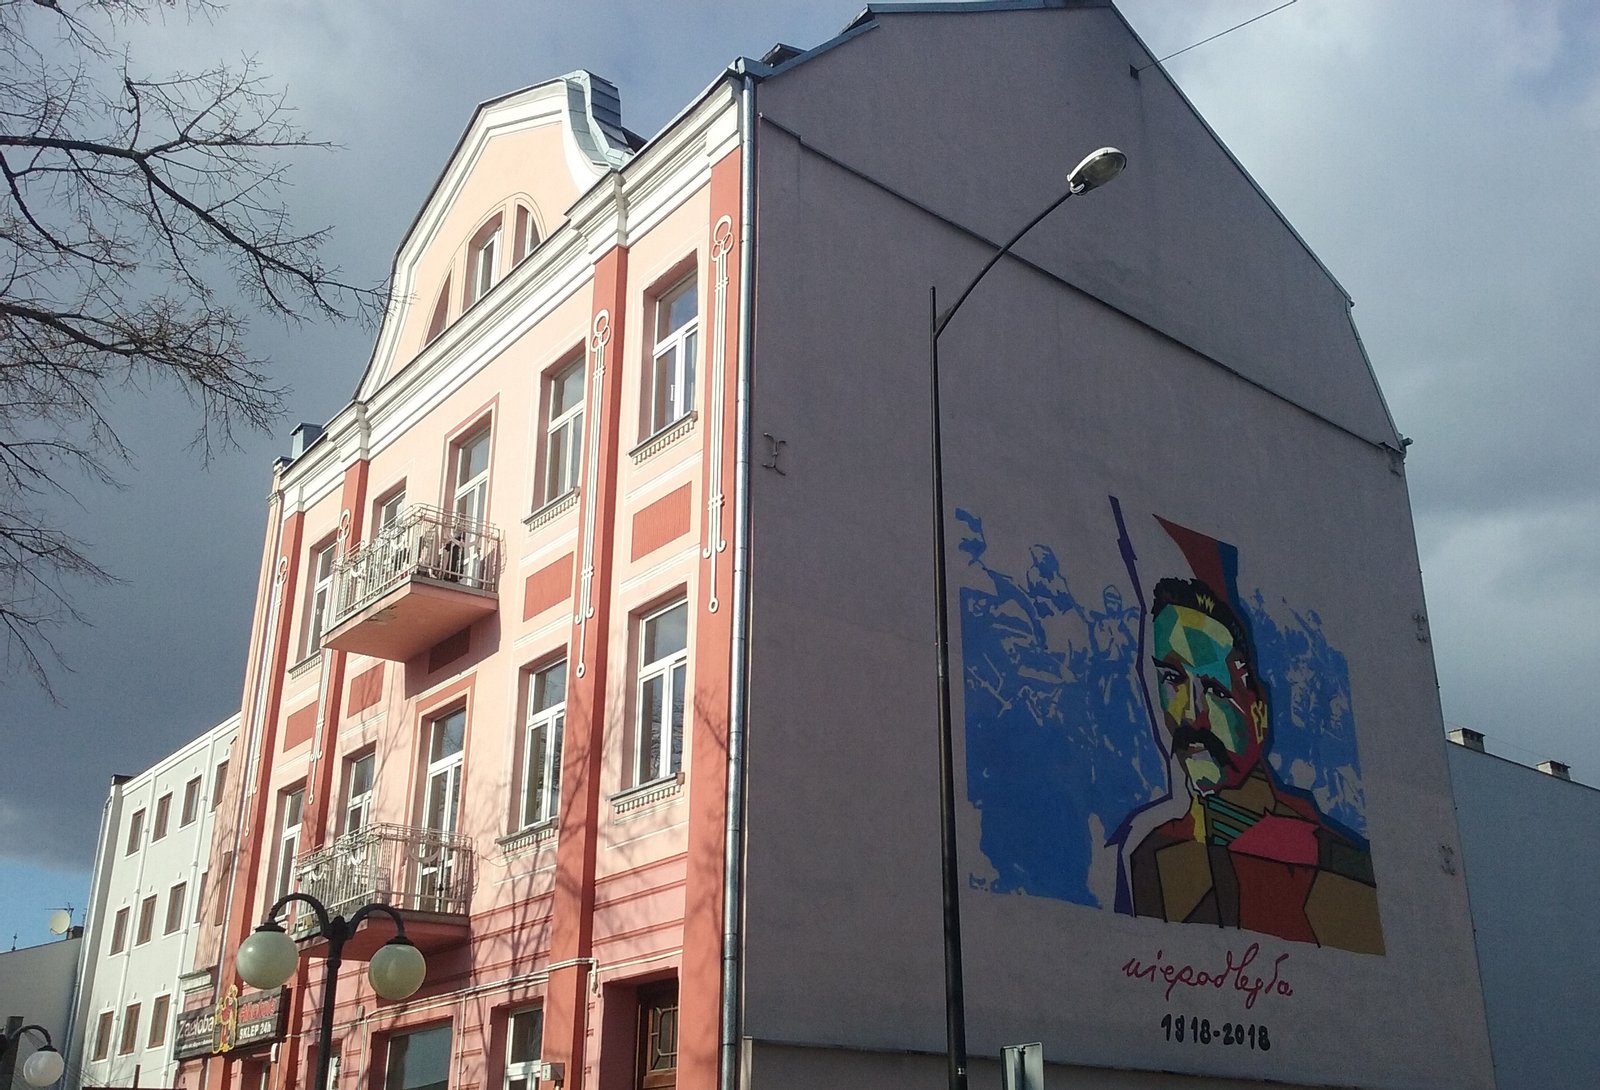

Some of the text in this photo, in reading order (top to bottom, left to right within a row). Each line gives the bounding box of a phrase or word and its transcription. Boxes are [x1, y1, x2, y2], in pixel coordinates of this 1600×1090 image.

[239, 1021, 272, 1040] SKLEP 24h
[1160, 1013, 1271, 1051] 1918-2018
